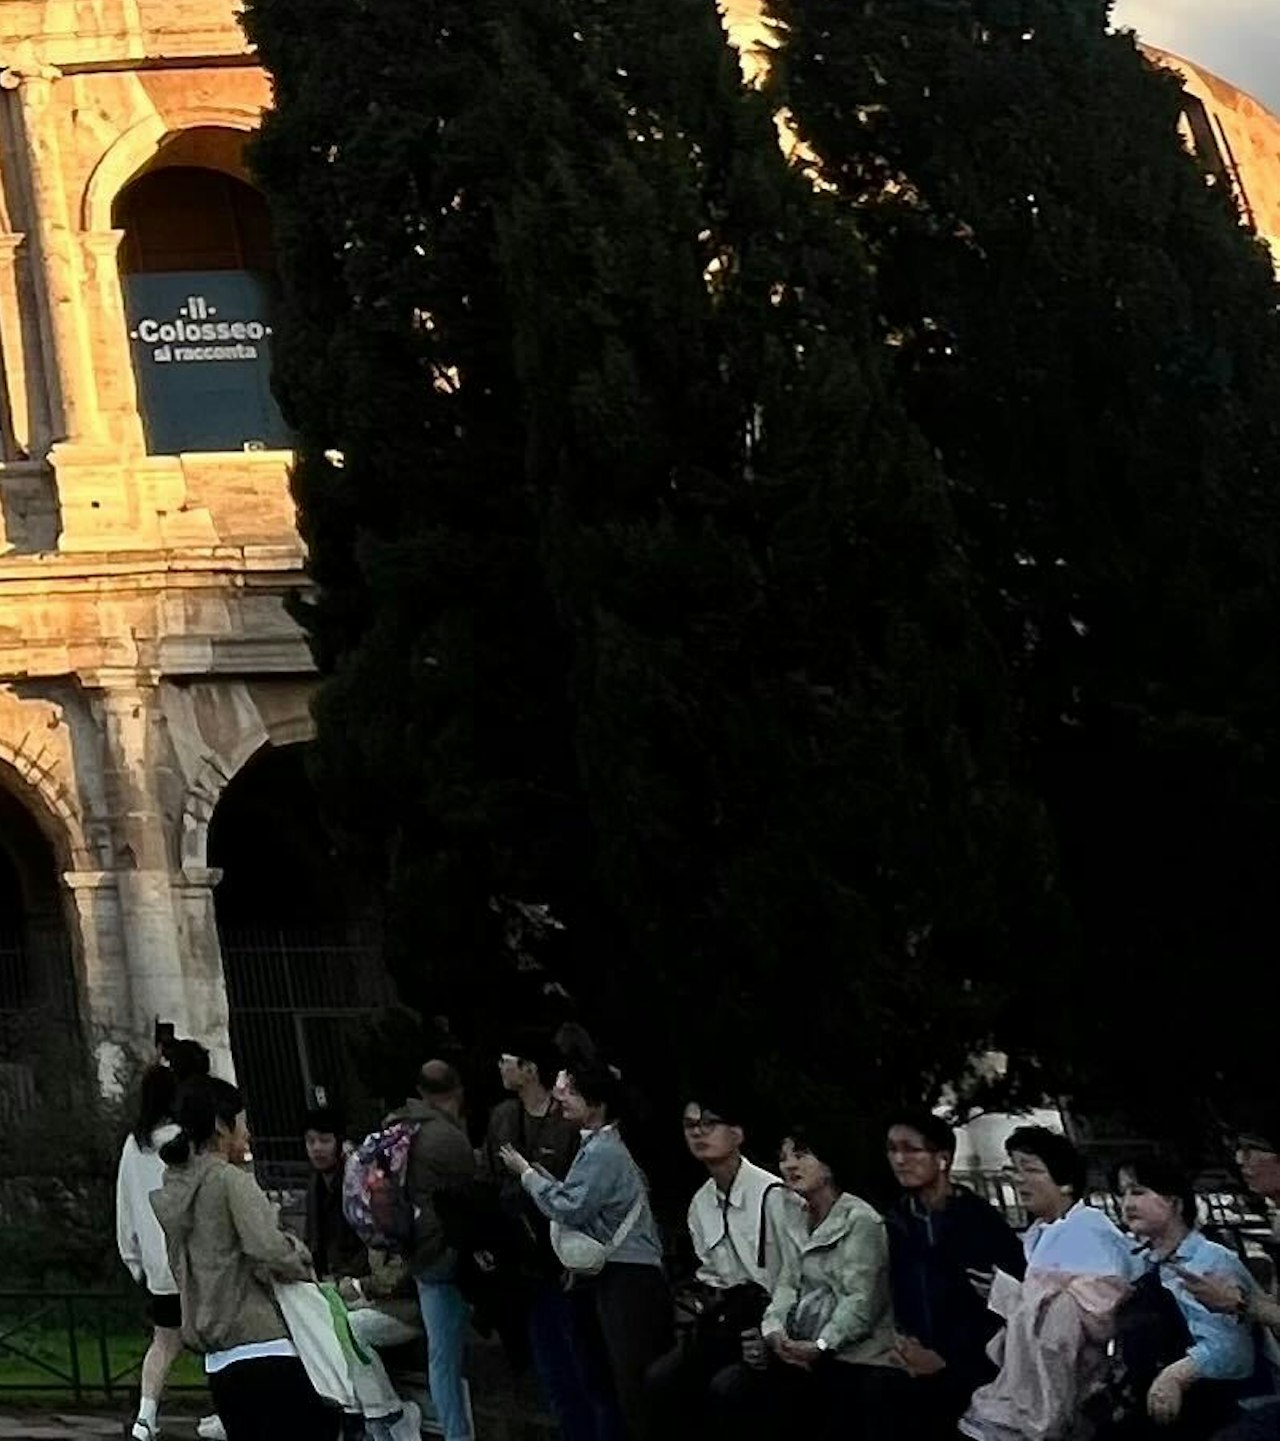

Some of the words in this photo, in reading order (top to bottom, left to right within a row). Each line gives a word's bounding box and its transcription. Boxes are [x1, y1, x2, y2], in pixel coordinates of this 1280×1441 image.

[187, 296, 207, 320] Il
[139, 318, 265, 343] Colosseo
[153, 344, 172, 362] si
[174, 343, 257, 361] racconta
